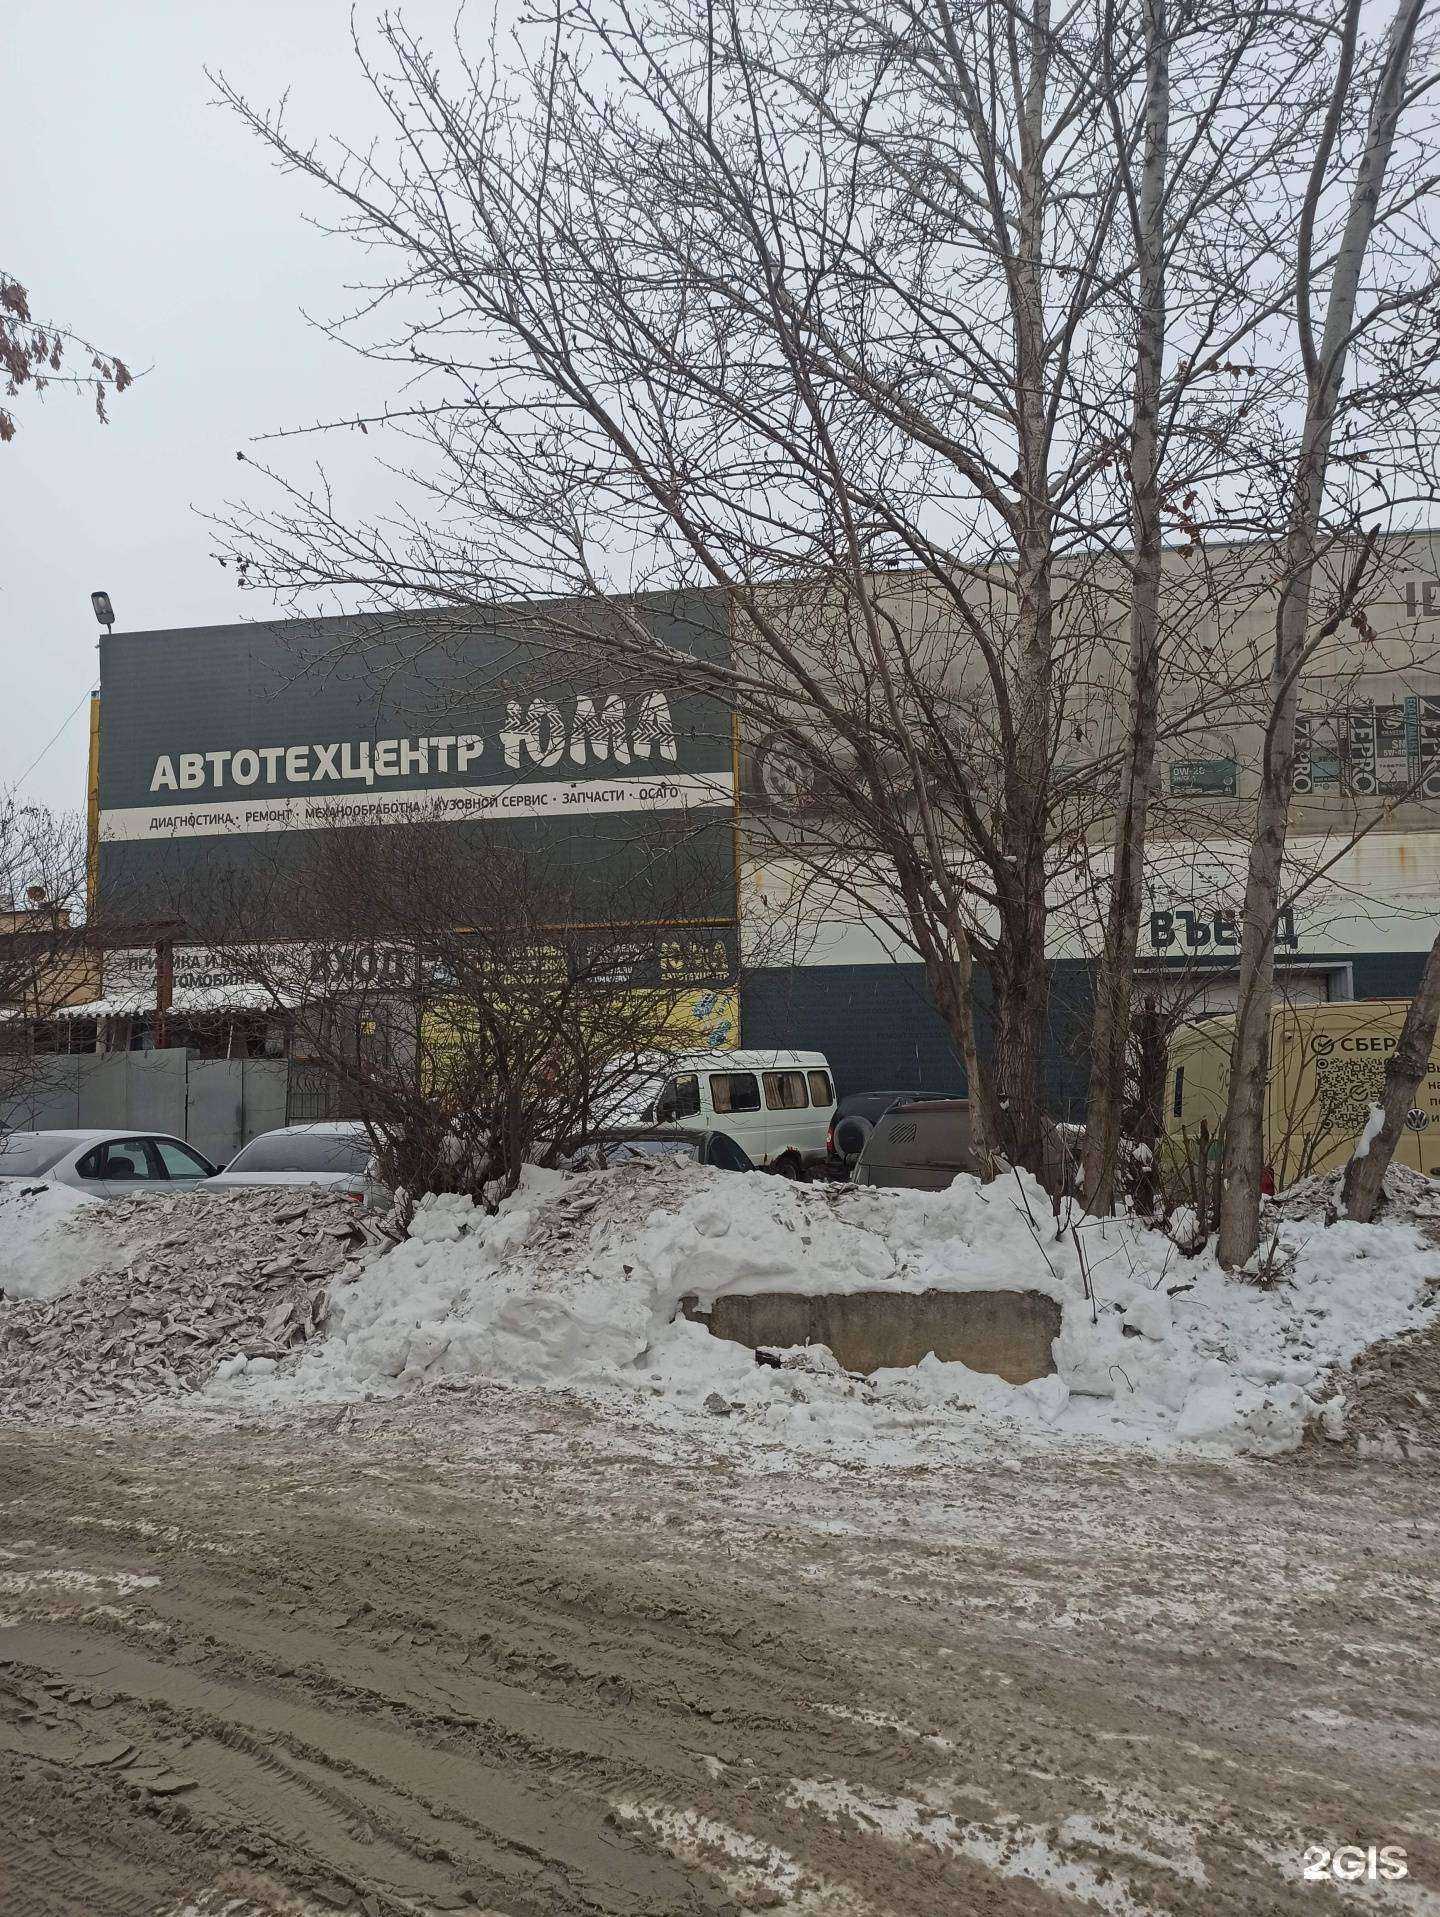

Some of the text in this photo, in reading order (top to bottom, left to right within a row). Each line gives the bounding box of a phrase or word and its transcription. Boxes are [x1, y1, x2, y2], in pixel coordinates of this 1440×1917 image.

[150, 690, 678, 792] АВТОТЕХЦЕНТР ЮМА
[149, 812, 231, 831] ДИАГНОСТИКА
[245, 809, 291, 822] РЕМОНТ
[501, 794, 548, 807] СЕРВИС
[562, 790, 625, 804] ЗАПЧАСТИ
[639, 785, 679, 799] ОСАГО
[1150, 909, 1299, 950] ВЪЕД
[128, 955, 201, 971] ПРИМКА
[1340, 1038, 1397, 1052] СБЕР
